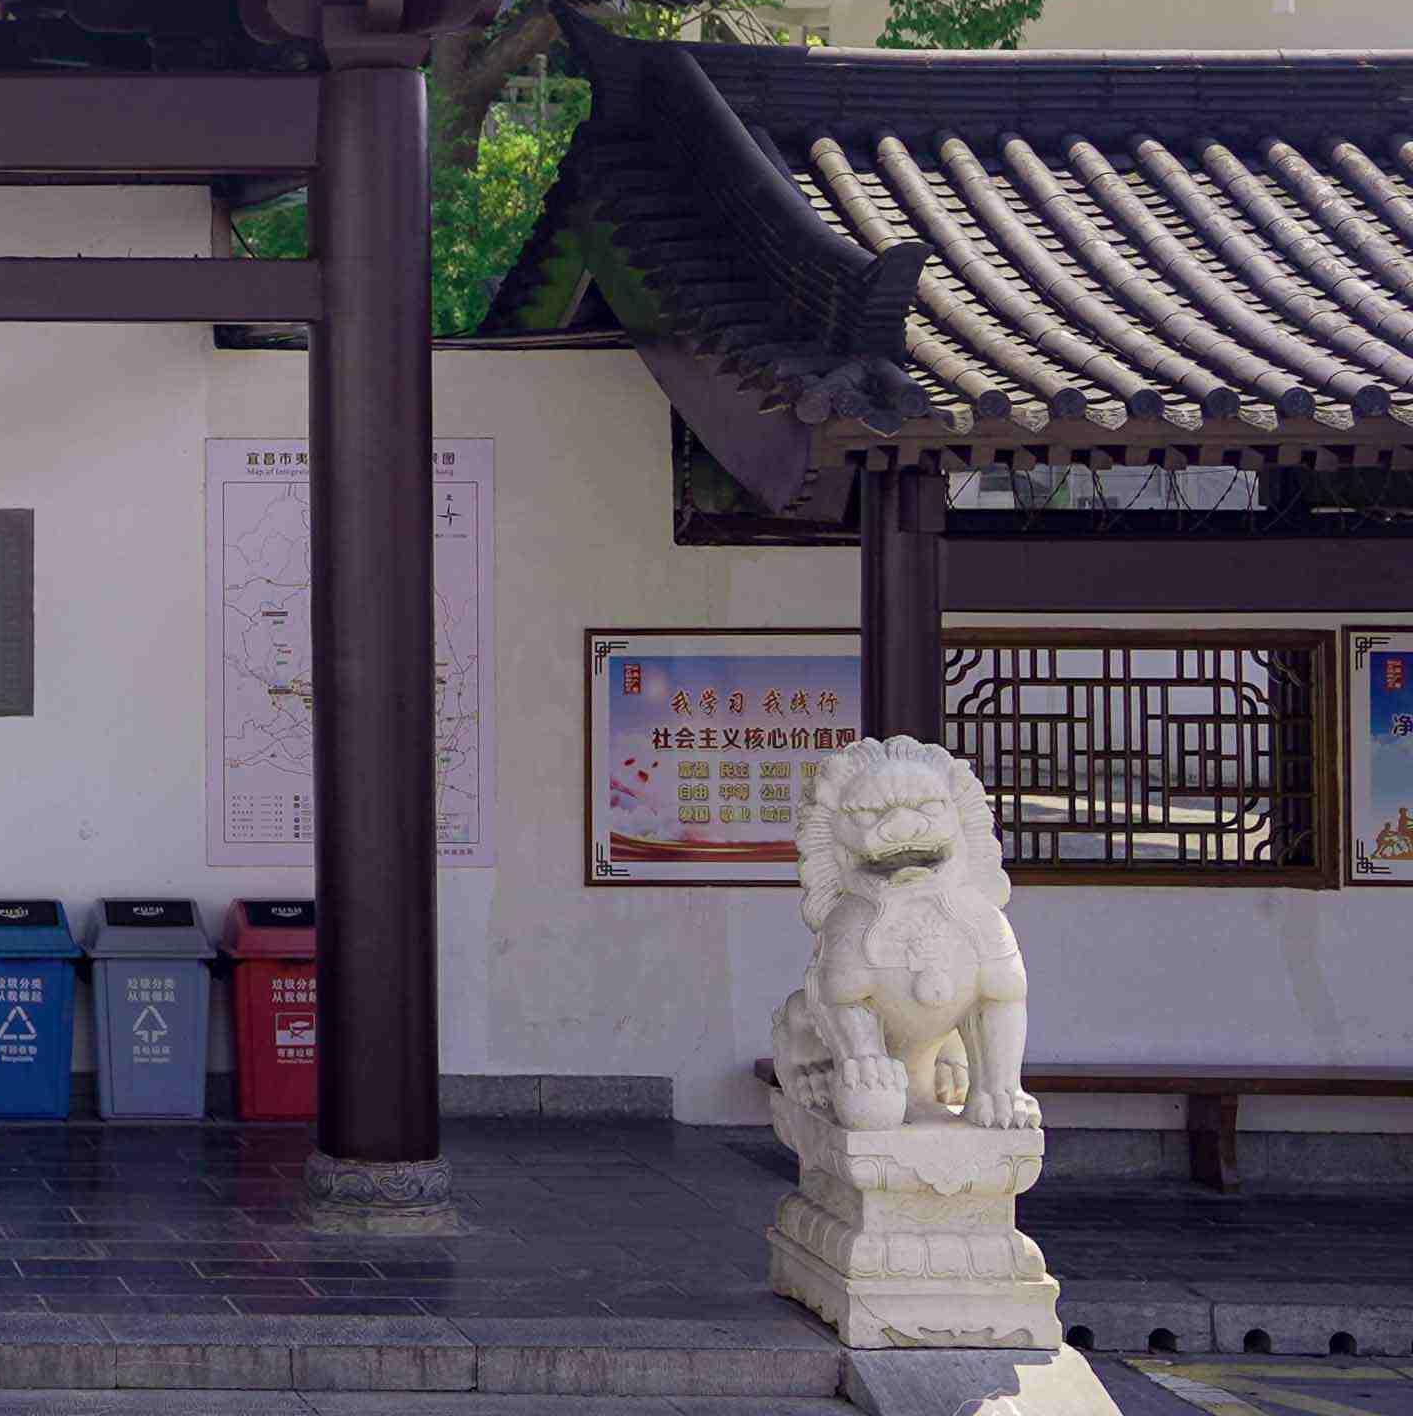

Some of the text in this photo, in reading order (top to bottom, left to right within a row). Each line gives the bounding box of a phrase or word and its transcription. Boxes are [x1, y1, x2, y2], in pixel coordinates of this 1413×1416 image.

[671, 689, 838, 717] 我学习 我践行
[652, 727, 856, 751] 社会主义核心价值观
[759, 761, 791, 779] 文明
[678, 784, 710, 801] 自由
[719, 784, 750, 801] 平等
[760, 784, 791, 801] 公正
[127, 978, 175, 990] 垃圾分类
[127, 990, 175, 1002] 从我做起
